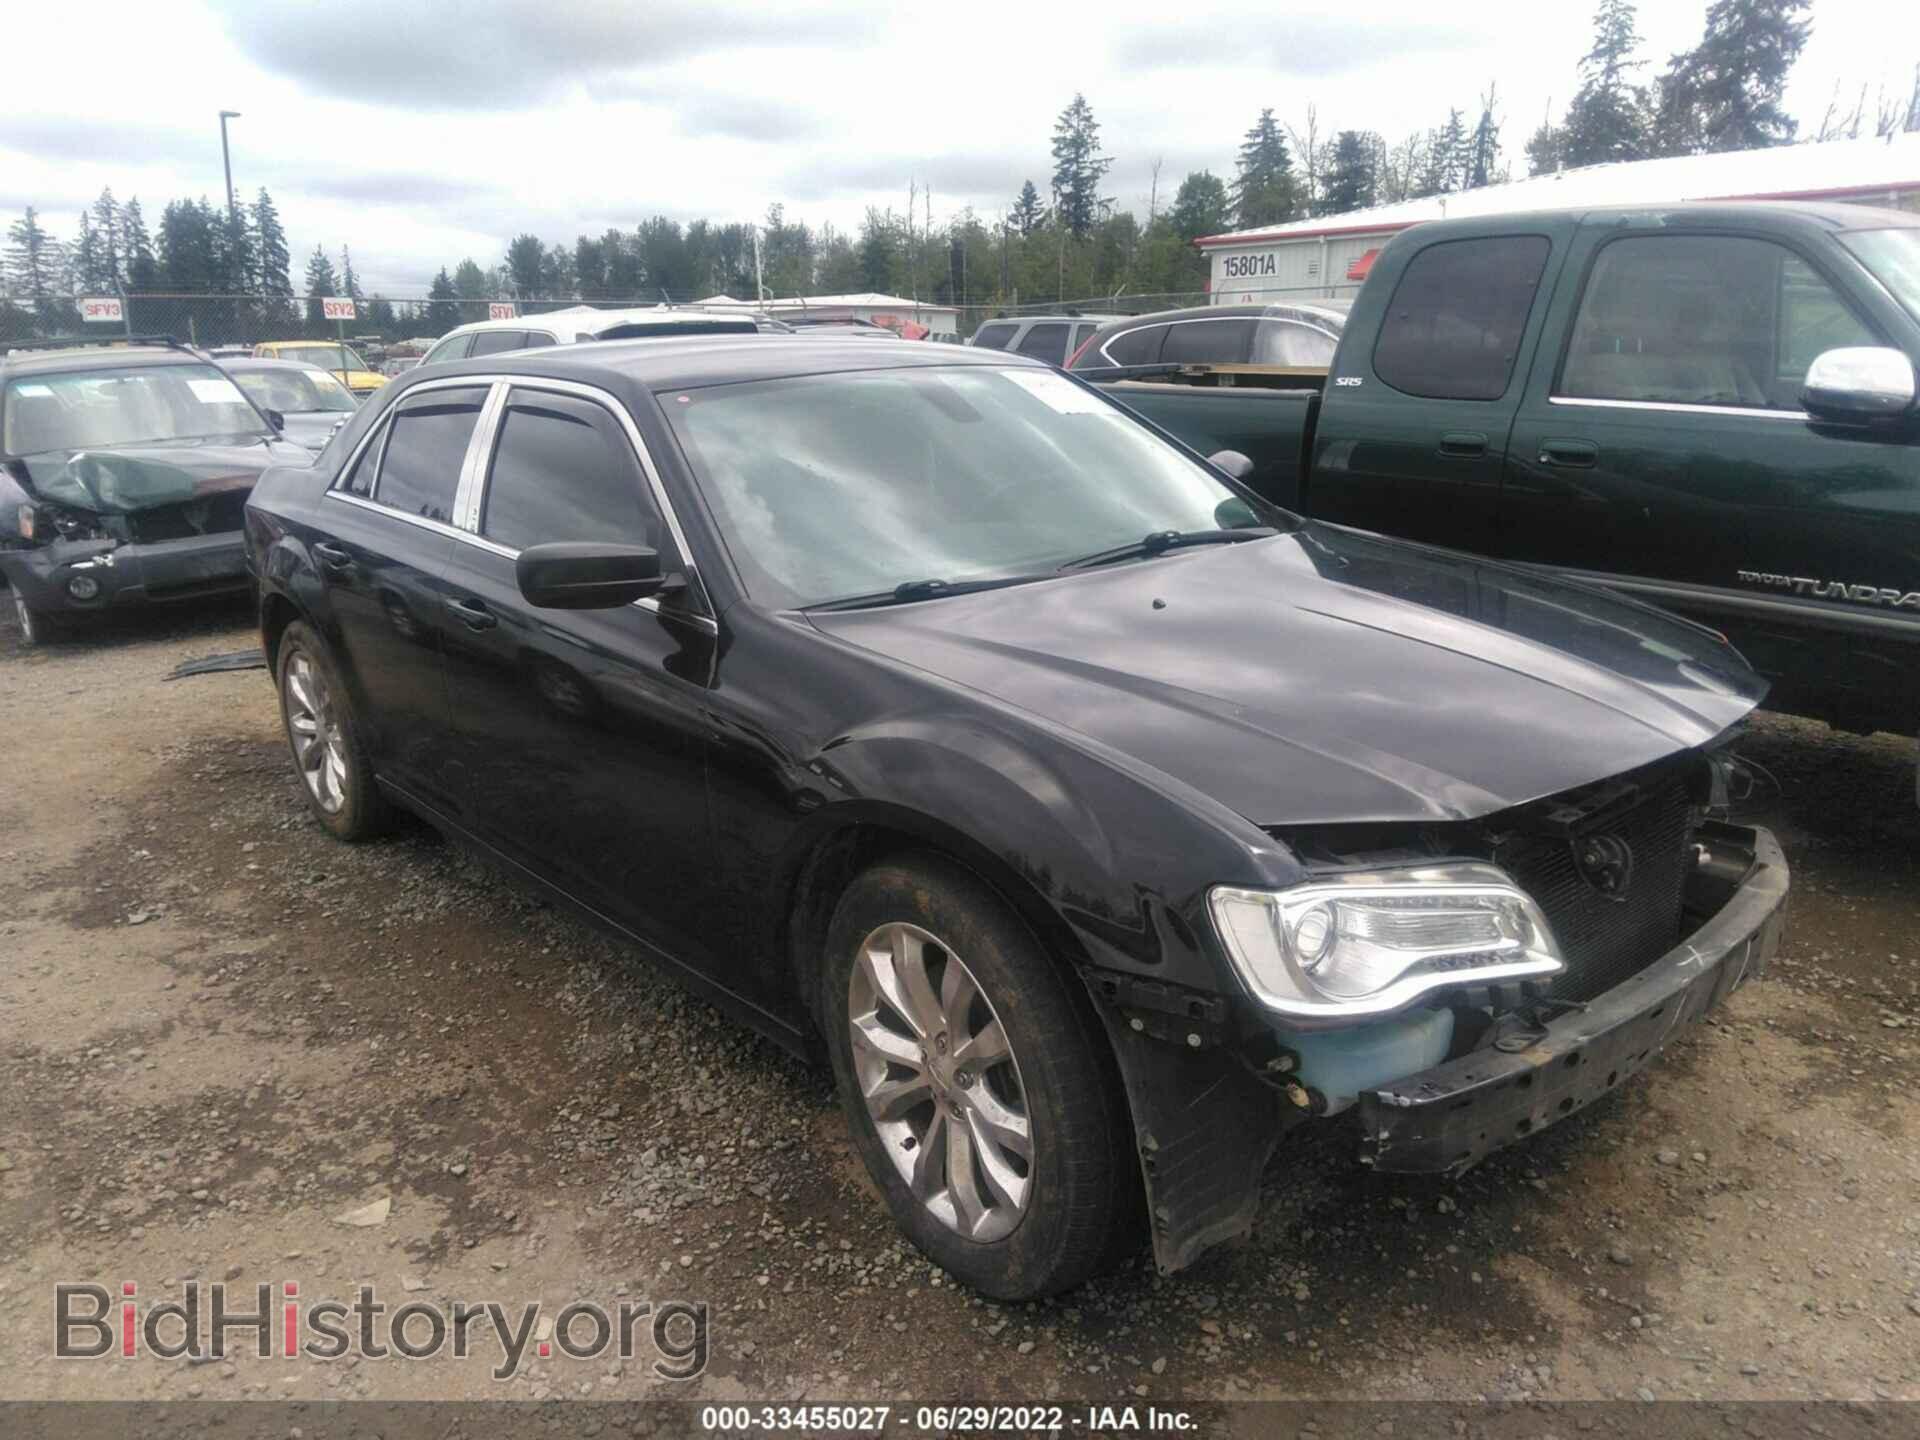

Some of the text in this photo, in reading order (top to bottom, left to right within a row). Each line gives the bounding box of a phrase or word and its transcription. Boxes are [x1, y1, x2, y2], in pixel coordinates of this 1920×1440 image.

[1223, 254, 1276, 277] 15801A
[86, 303, 120, 316] SFV3
[325, 302, 353, 316] SFV2
[1737, 570, 1791, 586] TOYOTA
